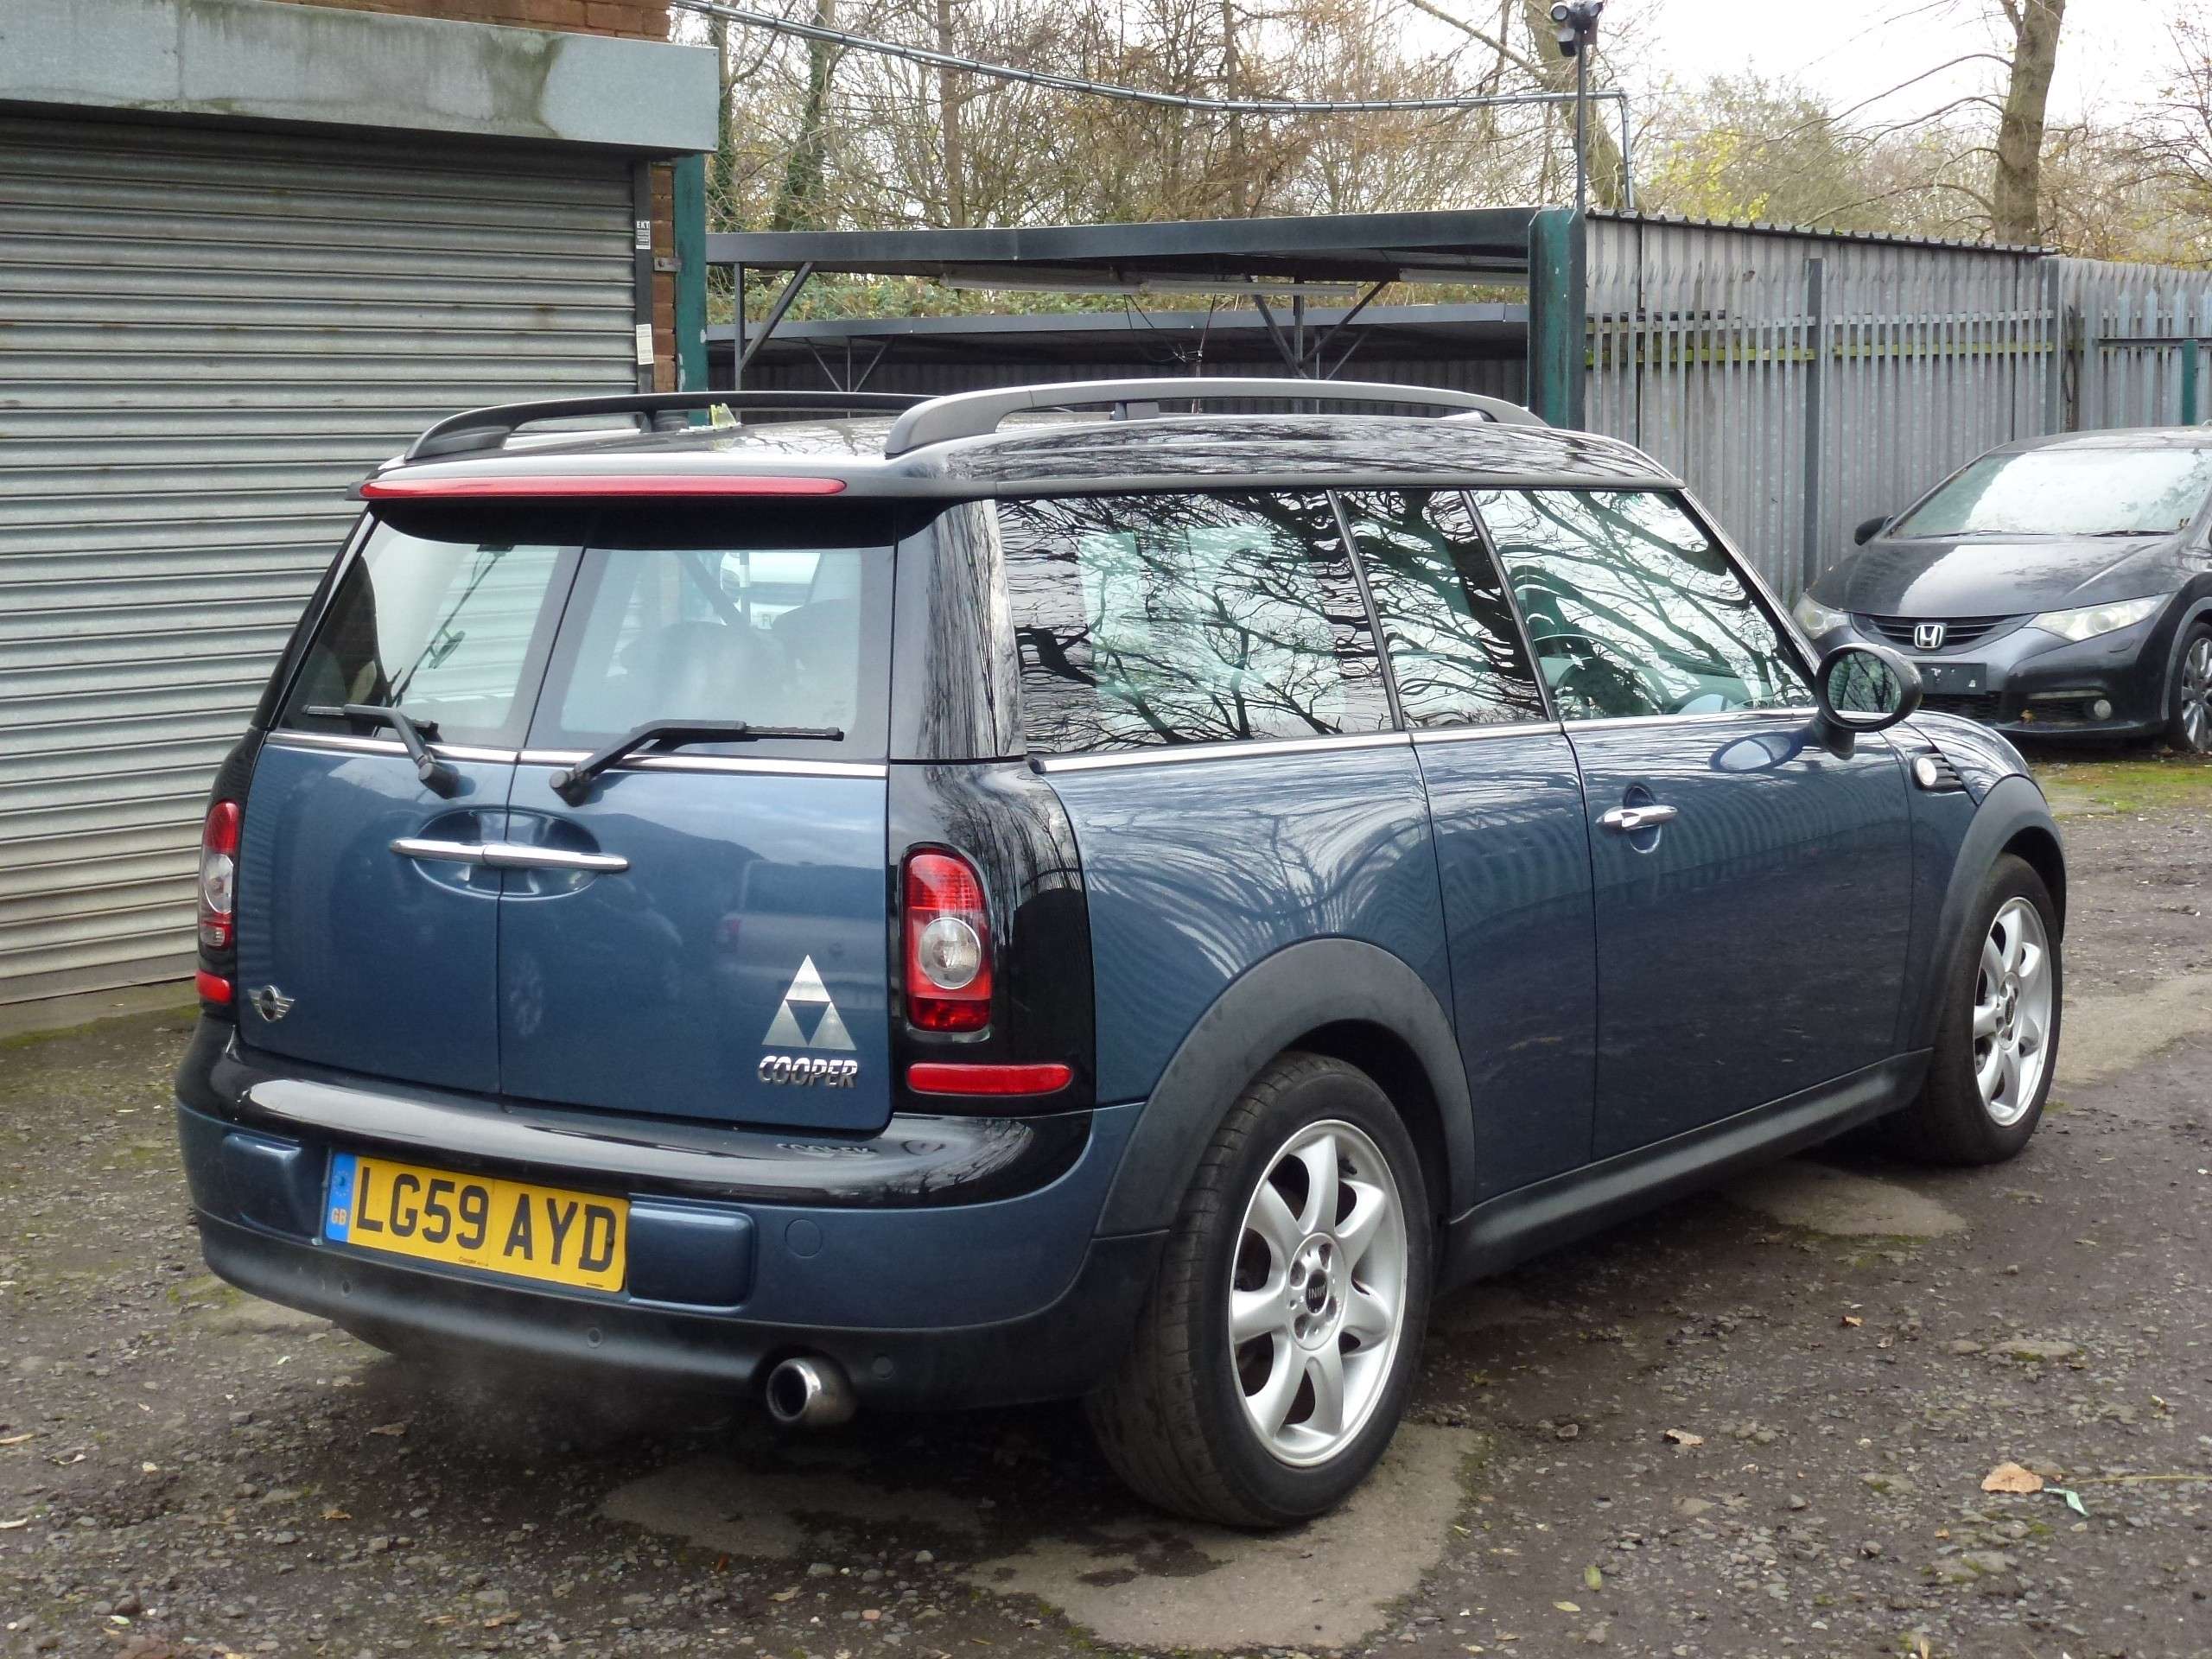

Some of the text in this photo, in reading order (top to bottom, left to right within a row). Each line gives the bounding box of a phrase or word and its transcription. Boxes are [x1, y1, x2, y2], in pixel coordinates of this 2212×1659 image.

[758, 1055, 858, 1088] COOPER
[331, 1208, 346, 1225] GB
[356, 1166, 617, 1273] LG59 AYD
